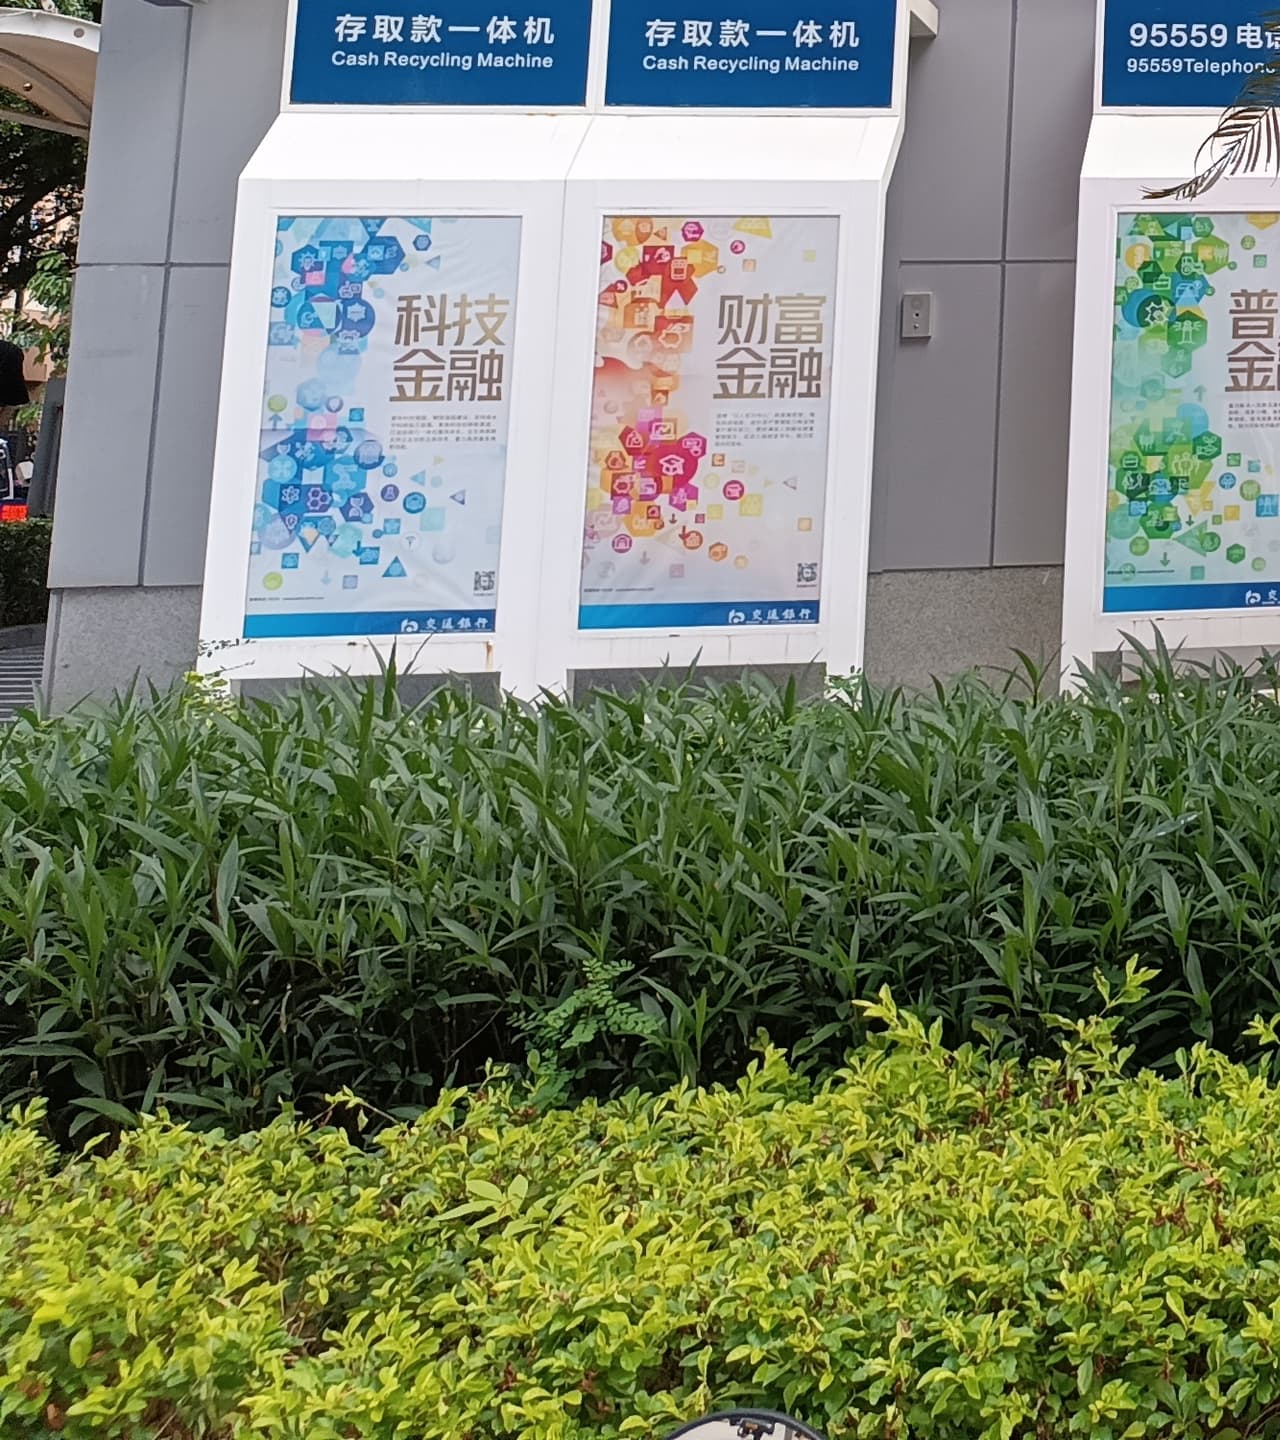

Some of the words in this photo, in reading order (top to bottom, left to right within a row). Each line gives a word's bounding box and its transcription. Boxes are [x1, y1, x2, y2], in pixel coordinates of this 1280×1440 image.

[334, 14, 555, 45] 存取款一体机
[644, 19, 860, 49] 存取款一体机
[1129, 23, 1228, 49] 95559
[331, 50, 379, 70] Cash
[383, 51, 473, 73] Recycling
[476, 52, 554, 71] Machine
[642, 55, 689, 73] Cash
[693, 55, 780, 75] Recycling
[784, 56, 860, 74] Machine
[394, 293, 510, 346] 科技
[717, 293, 827, 344] 财富
[389, 348, 504, 402] 金融
[712, 346, 824, 400] 金融
